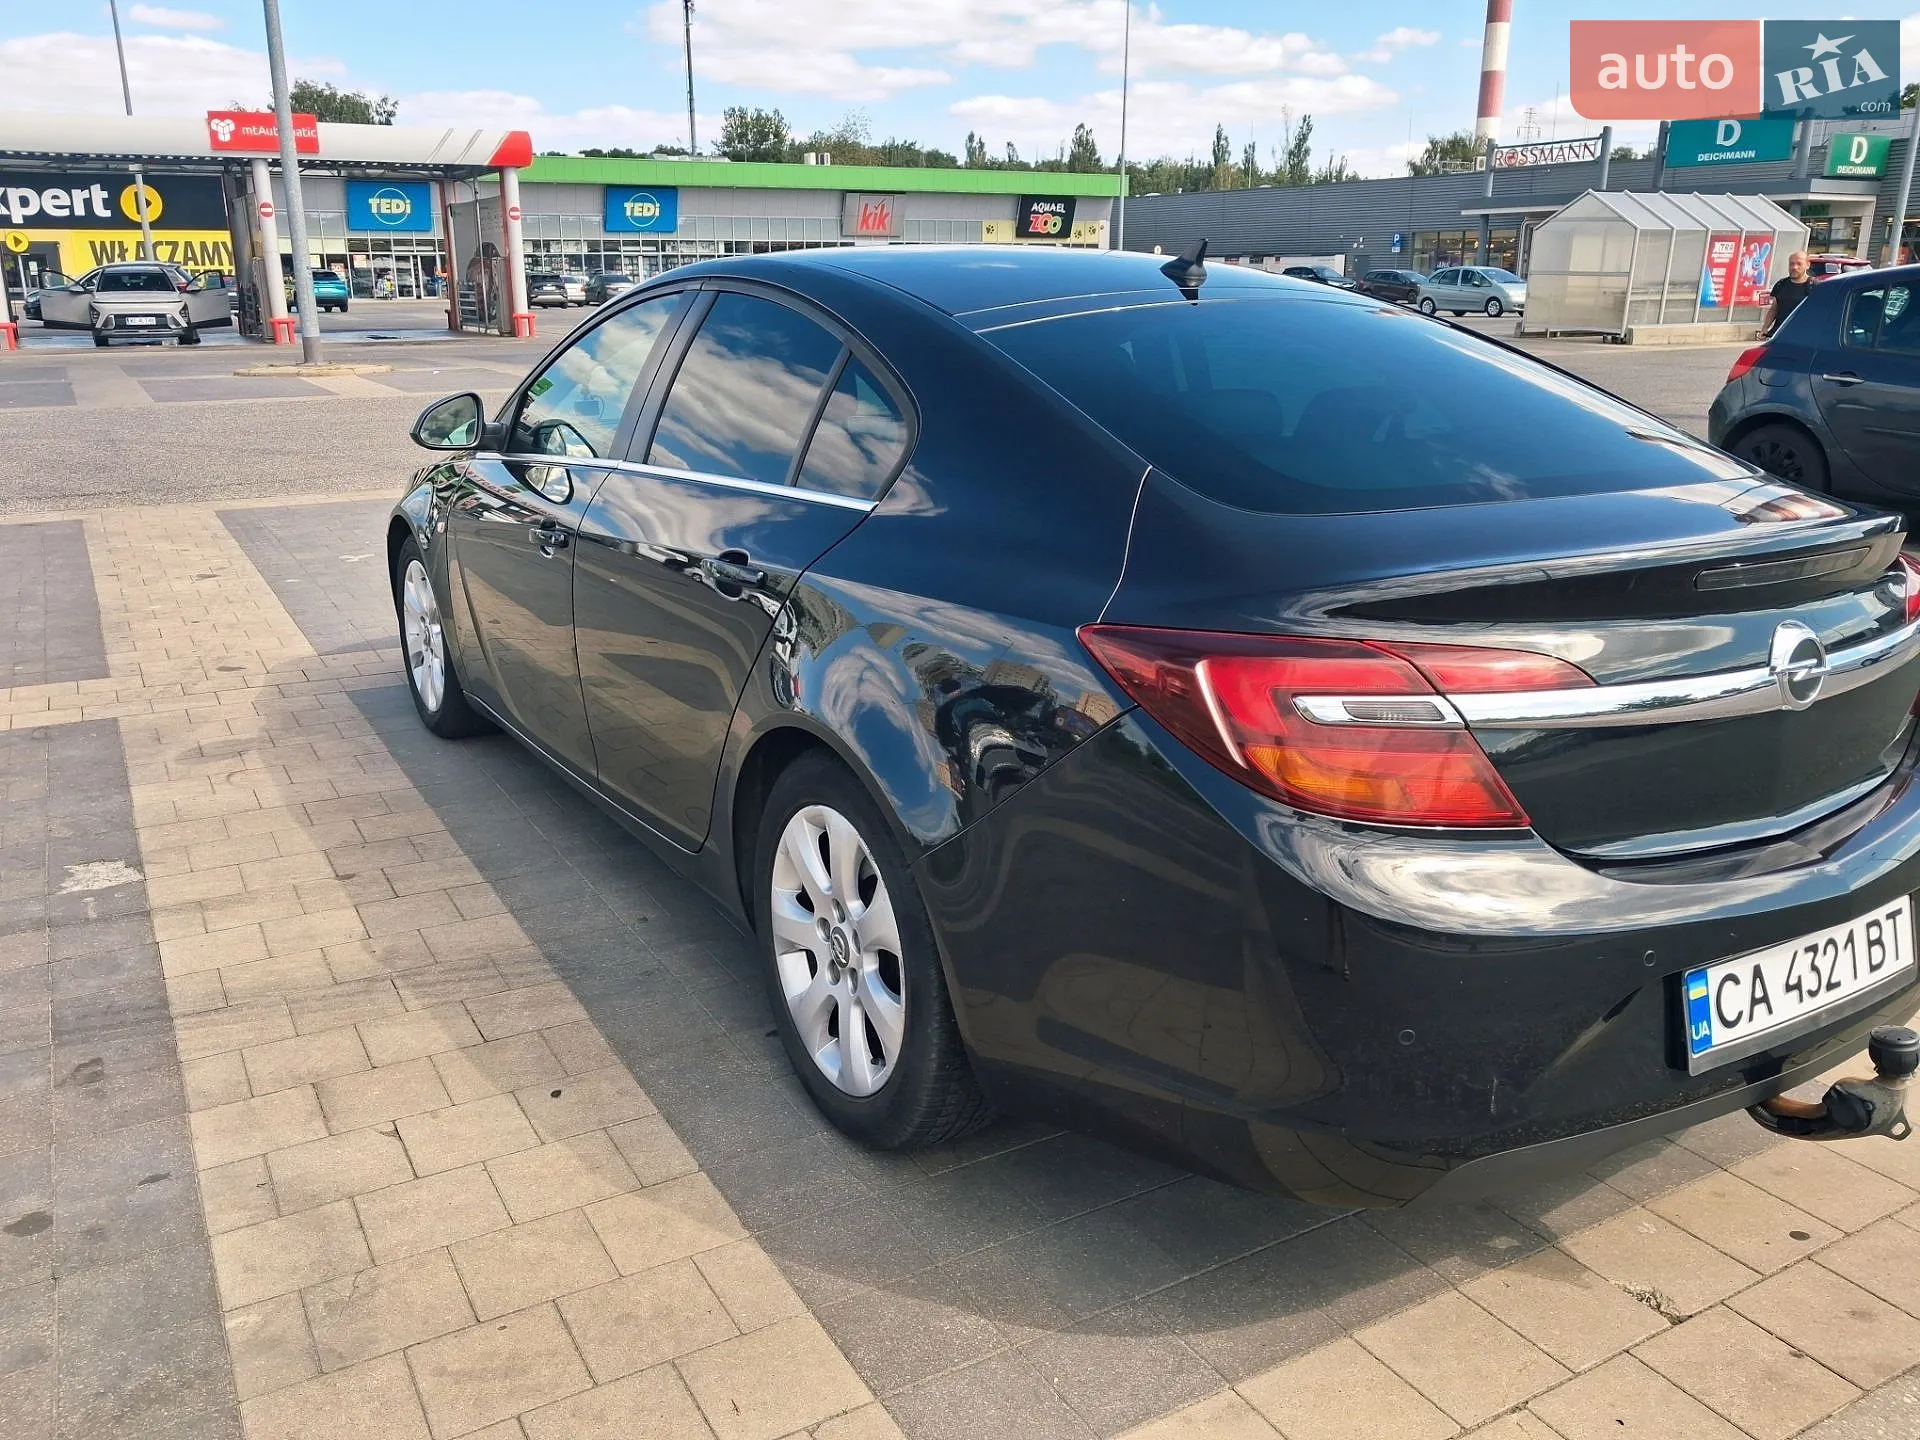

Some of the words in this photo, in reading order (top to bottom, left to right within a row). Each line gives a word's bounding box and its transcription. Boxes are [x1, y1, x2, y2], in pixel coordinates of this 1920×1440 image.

[242, 125, 316, 138] mtAutatic
[1716, 119, 1742, 147] D
[1493, 141, 1598, 169] ROSSMANN
[1697, 150, 1756, 162] DEICHMANN
[1850, 136, 1868, 164] D
[1837, 165, 1877, 176] DEICHMANN
[368, 198, 411, 214] TEDi
[623, 202, 660, 217] TEDi
[1031, 202, 1066, 214] AQUAEL
[860, 202, 890, 230] kik
[1028, 213, 1063, 234] ZOO
[1393, 233, 1400, 244] P
[1715, 963, 1774, 1029] CA
[1784, 928, 1859, 1004] 4321
[1865, 907, 1904, 975] BT
[1692, 1019, 1711, 1040] UA
